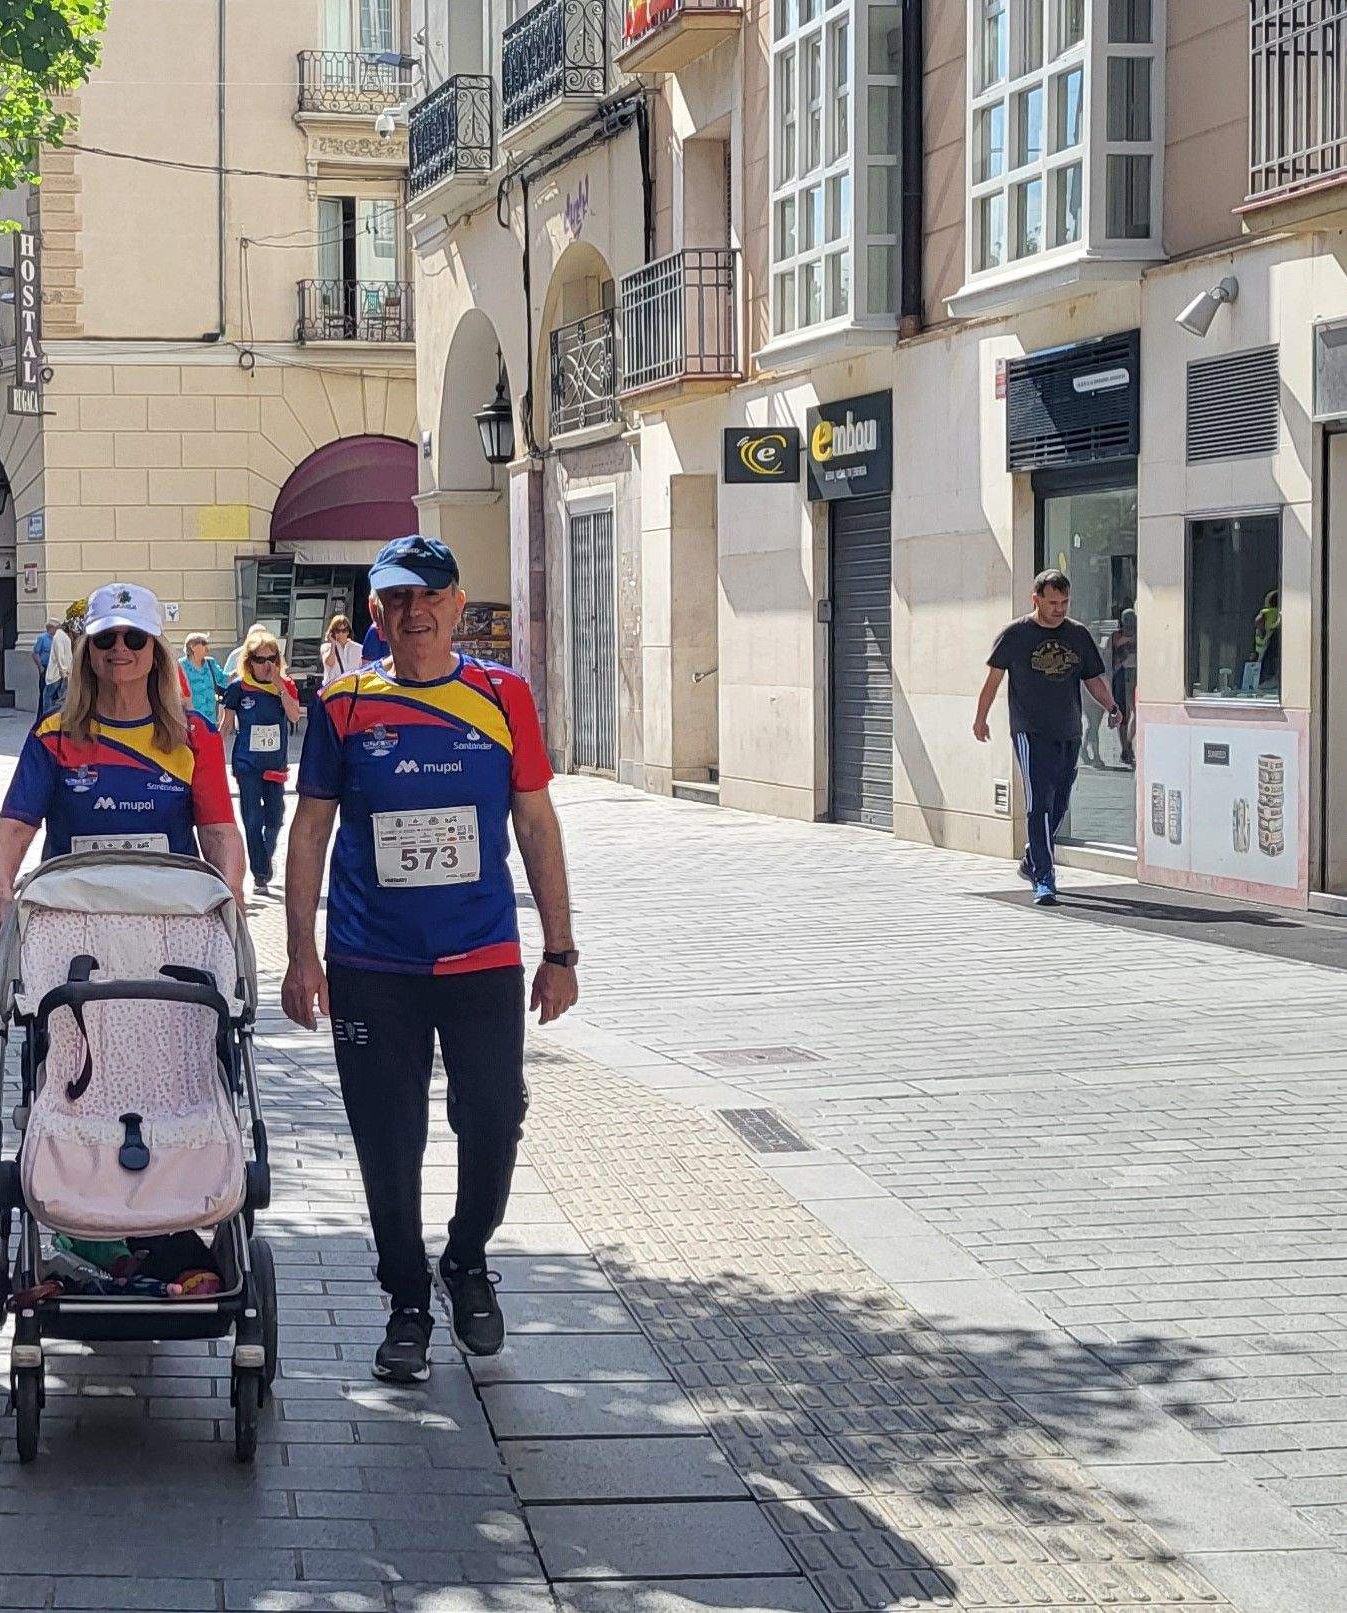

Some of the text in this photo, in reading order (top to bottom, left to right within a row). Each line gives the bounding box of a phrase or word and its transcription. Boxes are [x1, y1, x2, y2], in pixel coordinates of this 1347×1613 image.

[20, 233, 37, 384] HOSTAL
[812, 410, 877, 462] embou
[453, 741, 492, 750] Santander
[423, 760, 463, 774] mupol
[119, 799, 154, 812] mupol
[401, 845, 463, 871] 573
